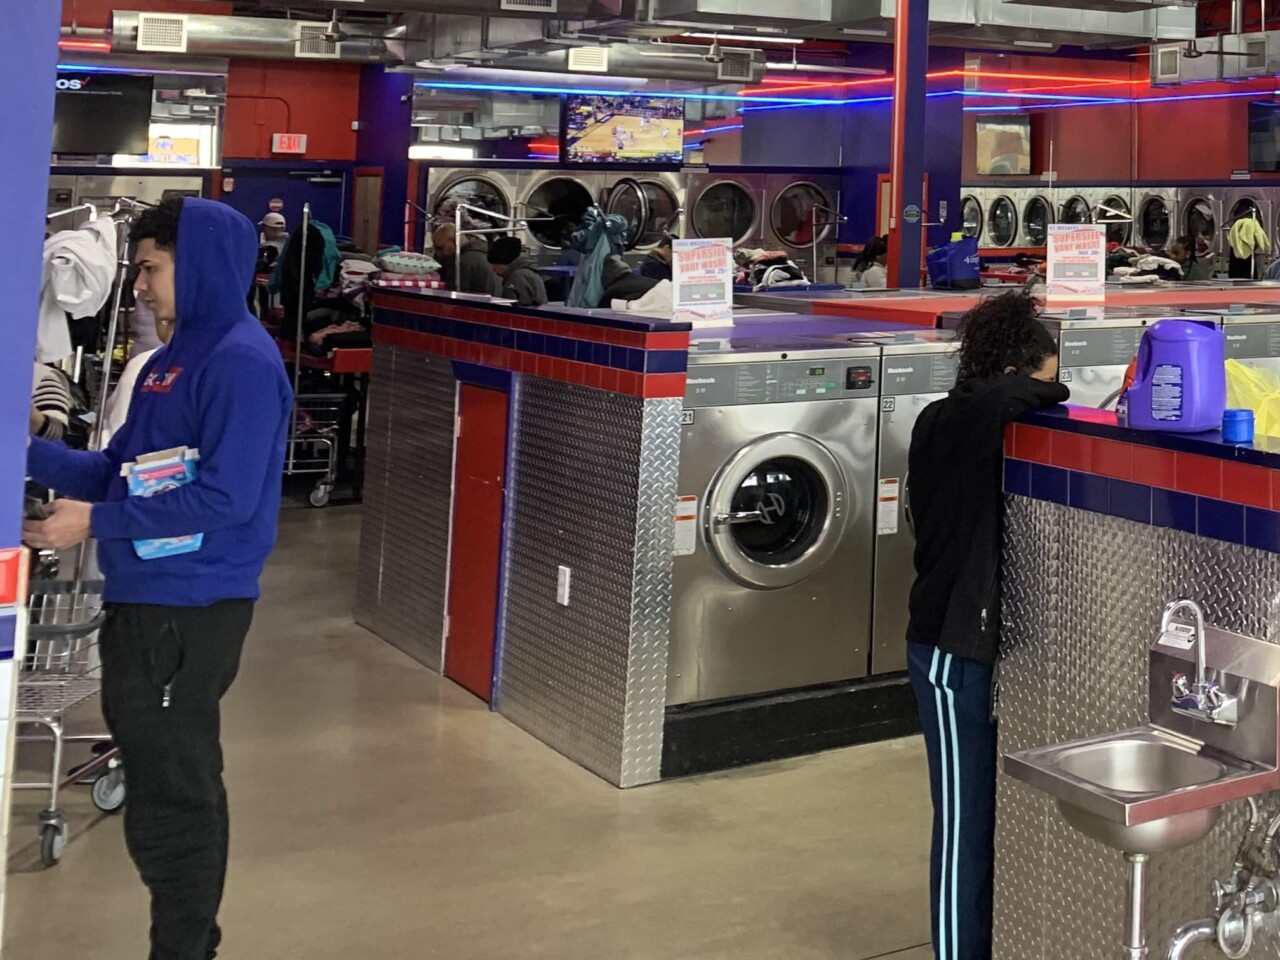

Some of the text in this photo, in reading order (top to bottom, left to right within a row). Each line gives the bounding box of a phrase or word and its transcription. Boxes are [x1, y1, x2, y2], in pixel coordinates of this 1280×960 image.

[56, 79, 81, 89] os
[1052, 231, 1100, 243] SUPERSIZE
[678, 246, 727, 262] SUPERSIZE
[1062, 370, 1071, 380] 23
[883, 400, 893, 409] 22
[682, 413, 692, 422] 21
